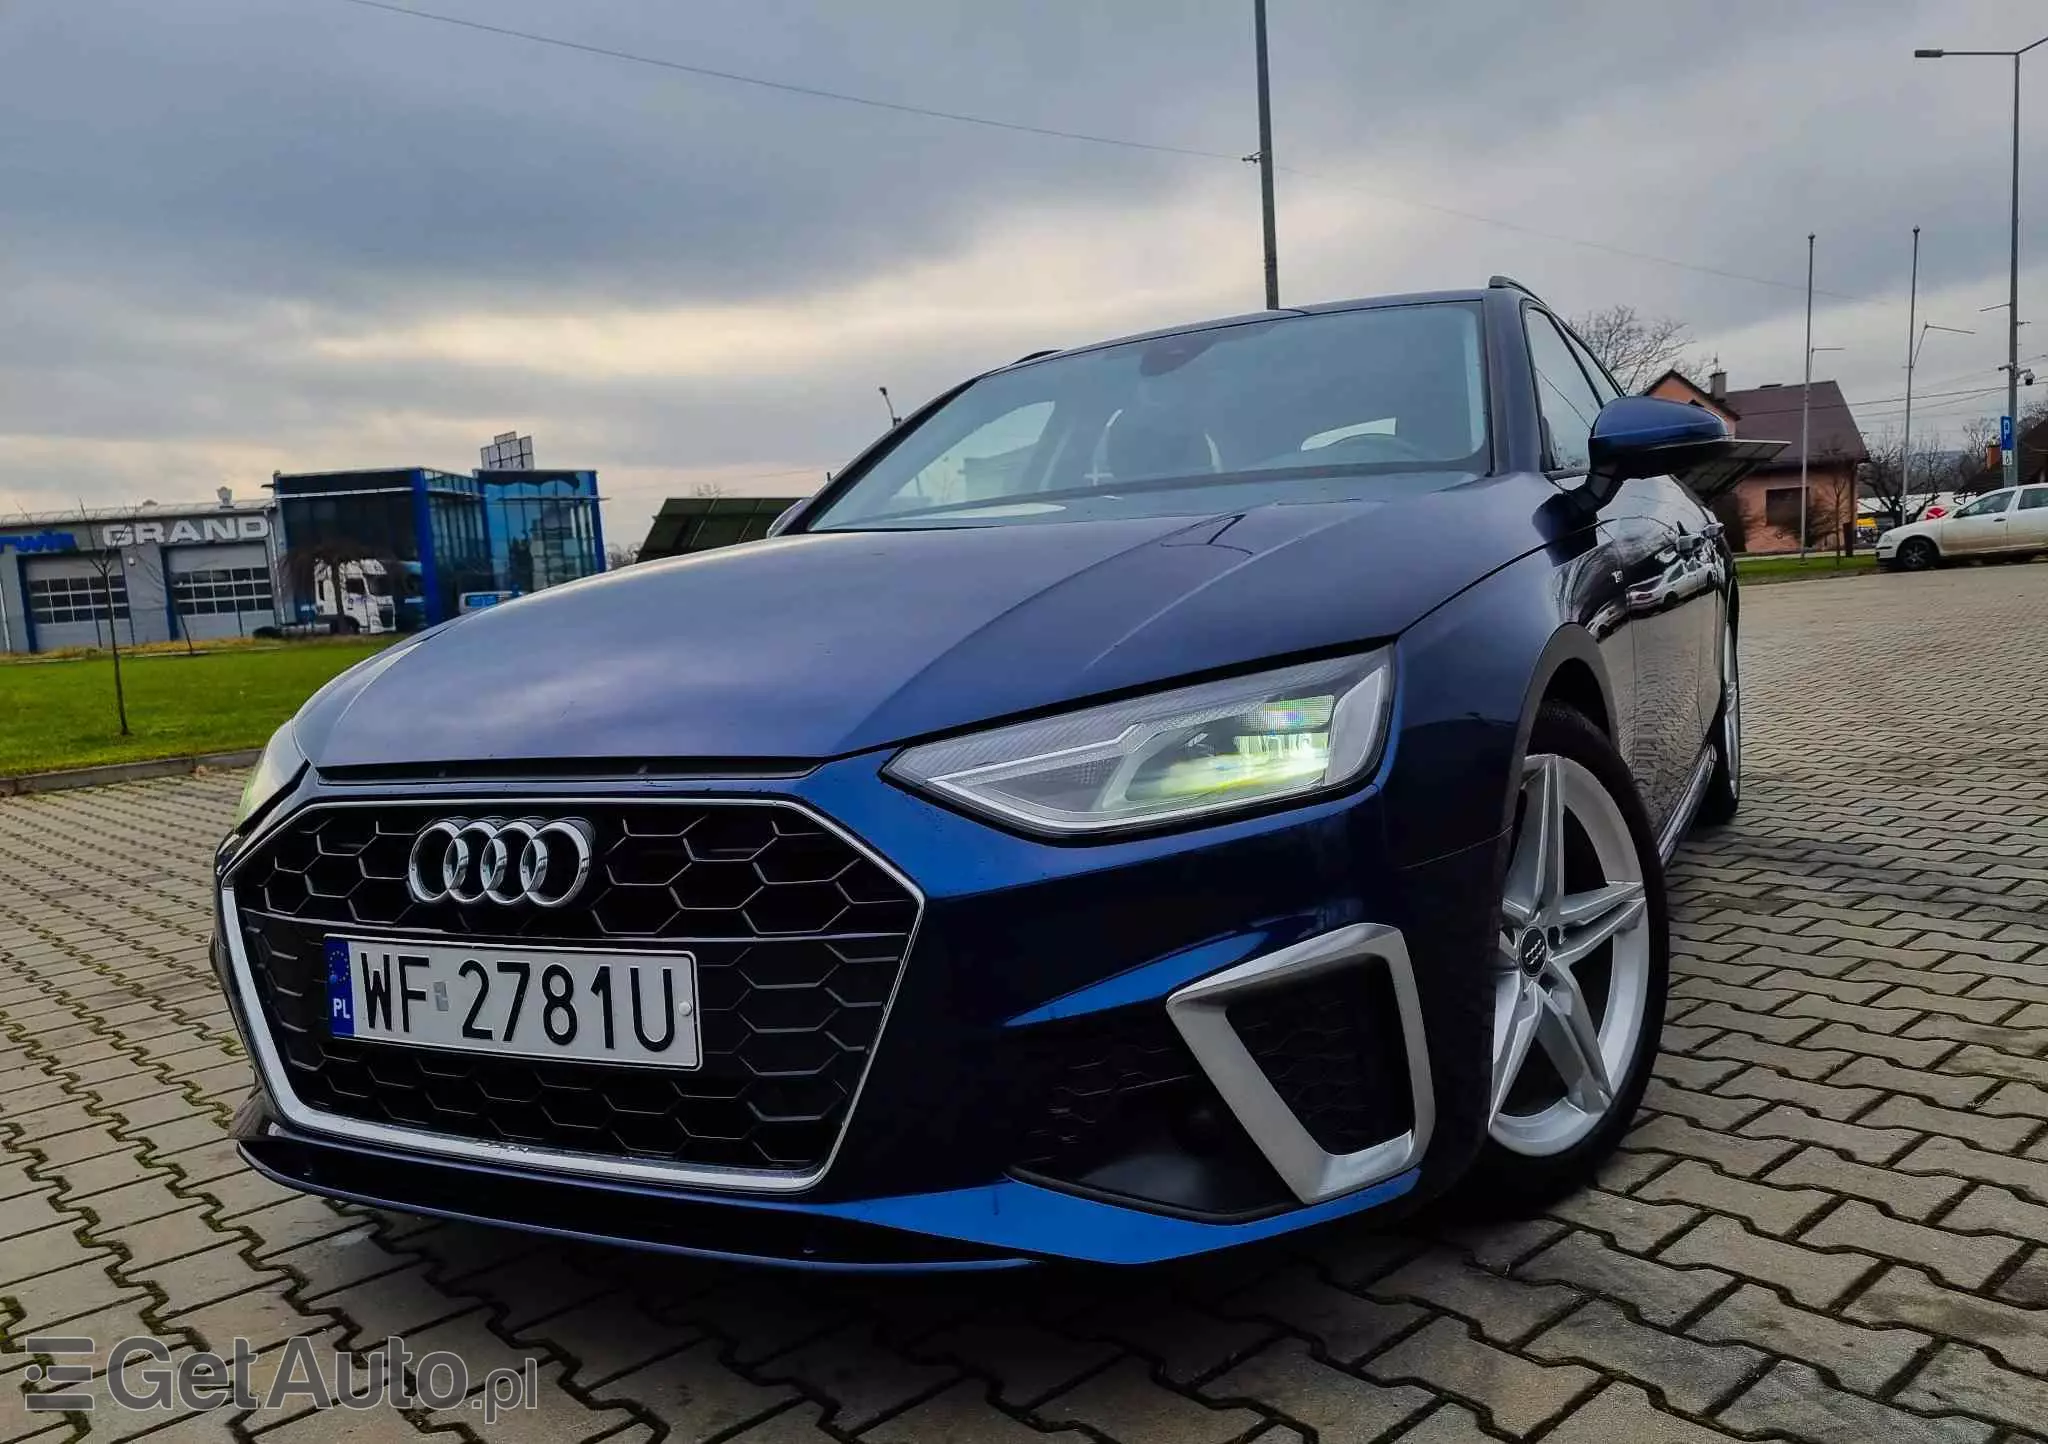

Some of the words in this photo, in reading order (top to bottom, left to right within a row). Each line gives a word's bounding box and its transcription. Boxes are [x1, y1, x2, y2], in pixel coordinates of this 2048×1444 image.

[102, 515, 270, 547] GRAND
[332, 997, 351, 1019] PL
[360, 951, 431, 1034] WF
[457, 958, 676, 1053] 2781U
